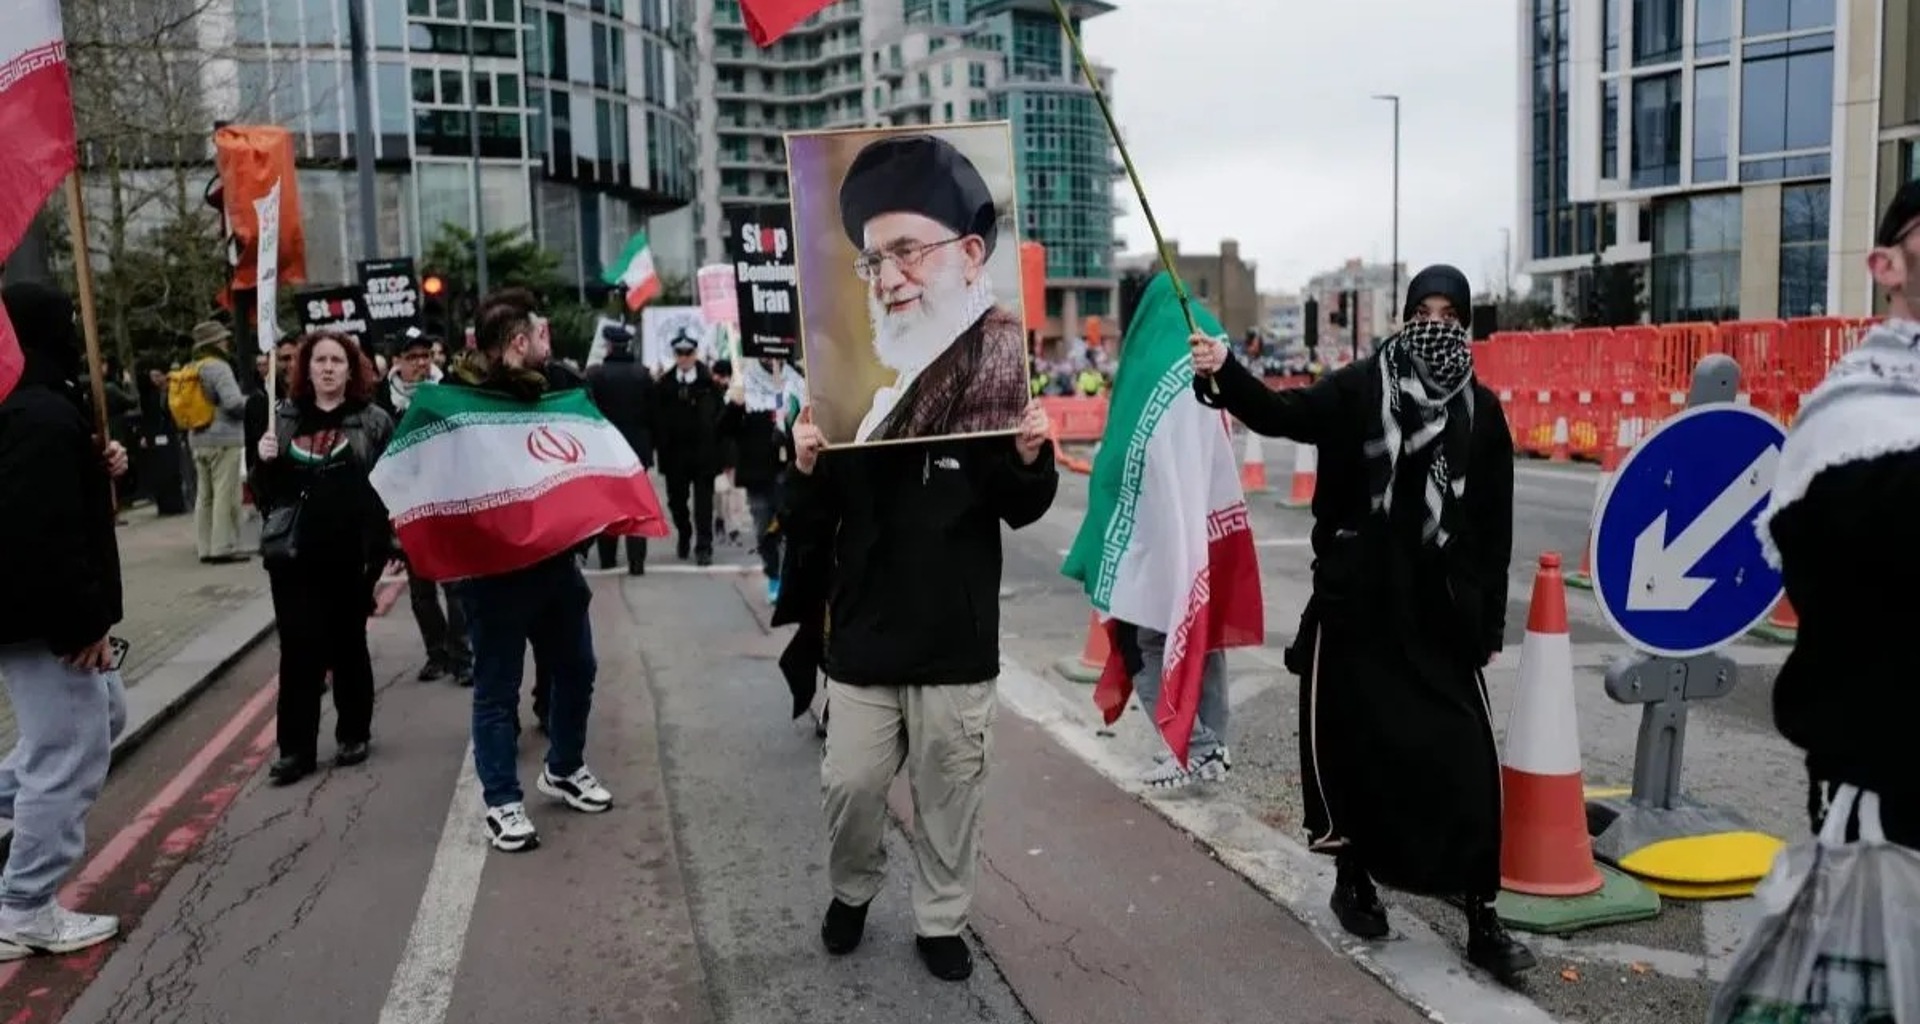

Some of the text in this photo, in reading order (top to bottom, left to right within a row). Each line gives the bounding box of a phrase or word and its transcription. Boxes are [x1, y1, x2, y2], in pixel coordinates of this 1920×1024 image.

[742, 222, 788, 258] Stop
[367, 276, 410, 293] STOP
[738, 261, 796, 286] Bombing
[307, 299, 356, 320] Stop
[752, 283, 790, 313] Iran
[369, 302, 416, 319] WARS
